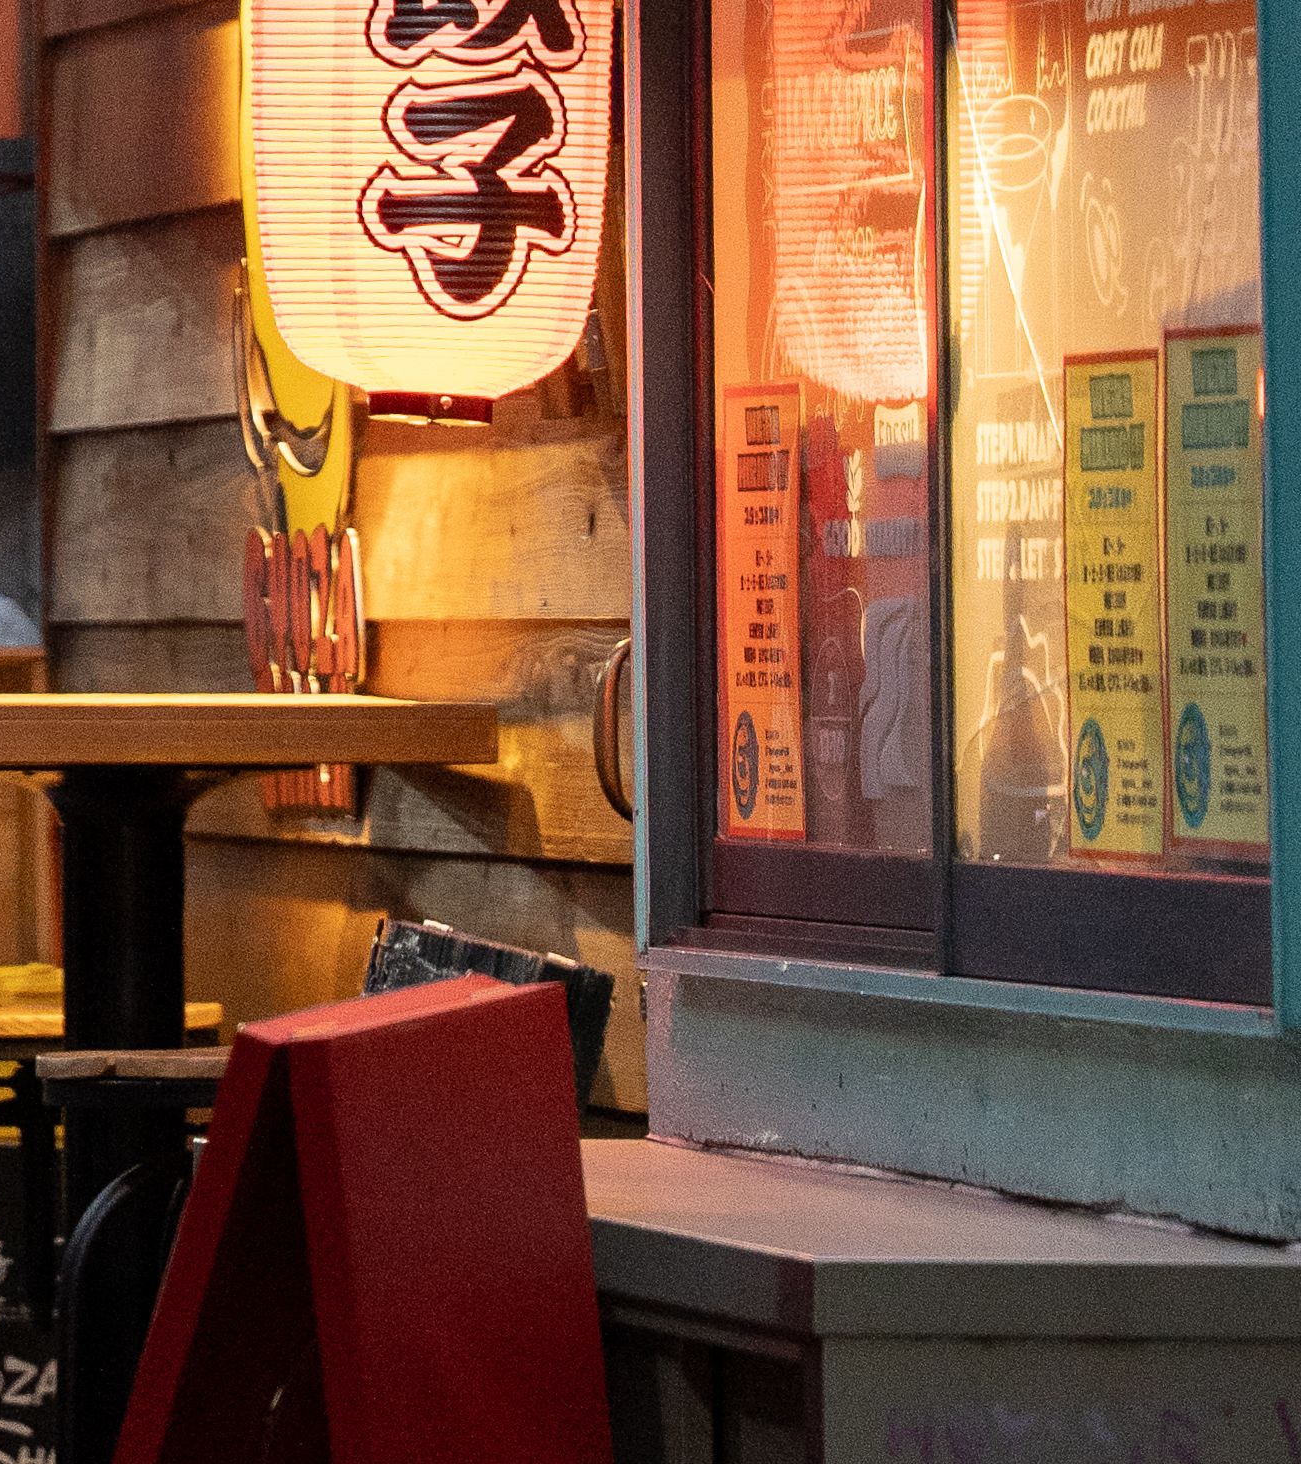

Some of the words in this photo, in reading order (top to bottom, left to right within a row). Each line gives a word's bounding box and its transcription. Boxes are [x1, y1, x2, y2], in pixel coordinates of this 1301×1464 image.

[1085, 29, 1129, 80] CRAFT
[1129, 21, 1165, 72] COLA
[1085, 82, 1148, 135] COCKTAIL
